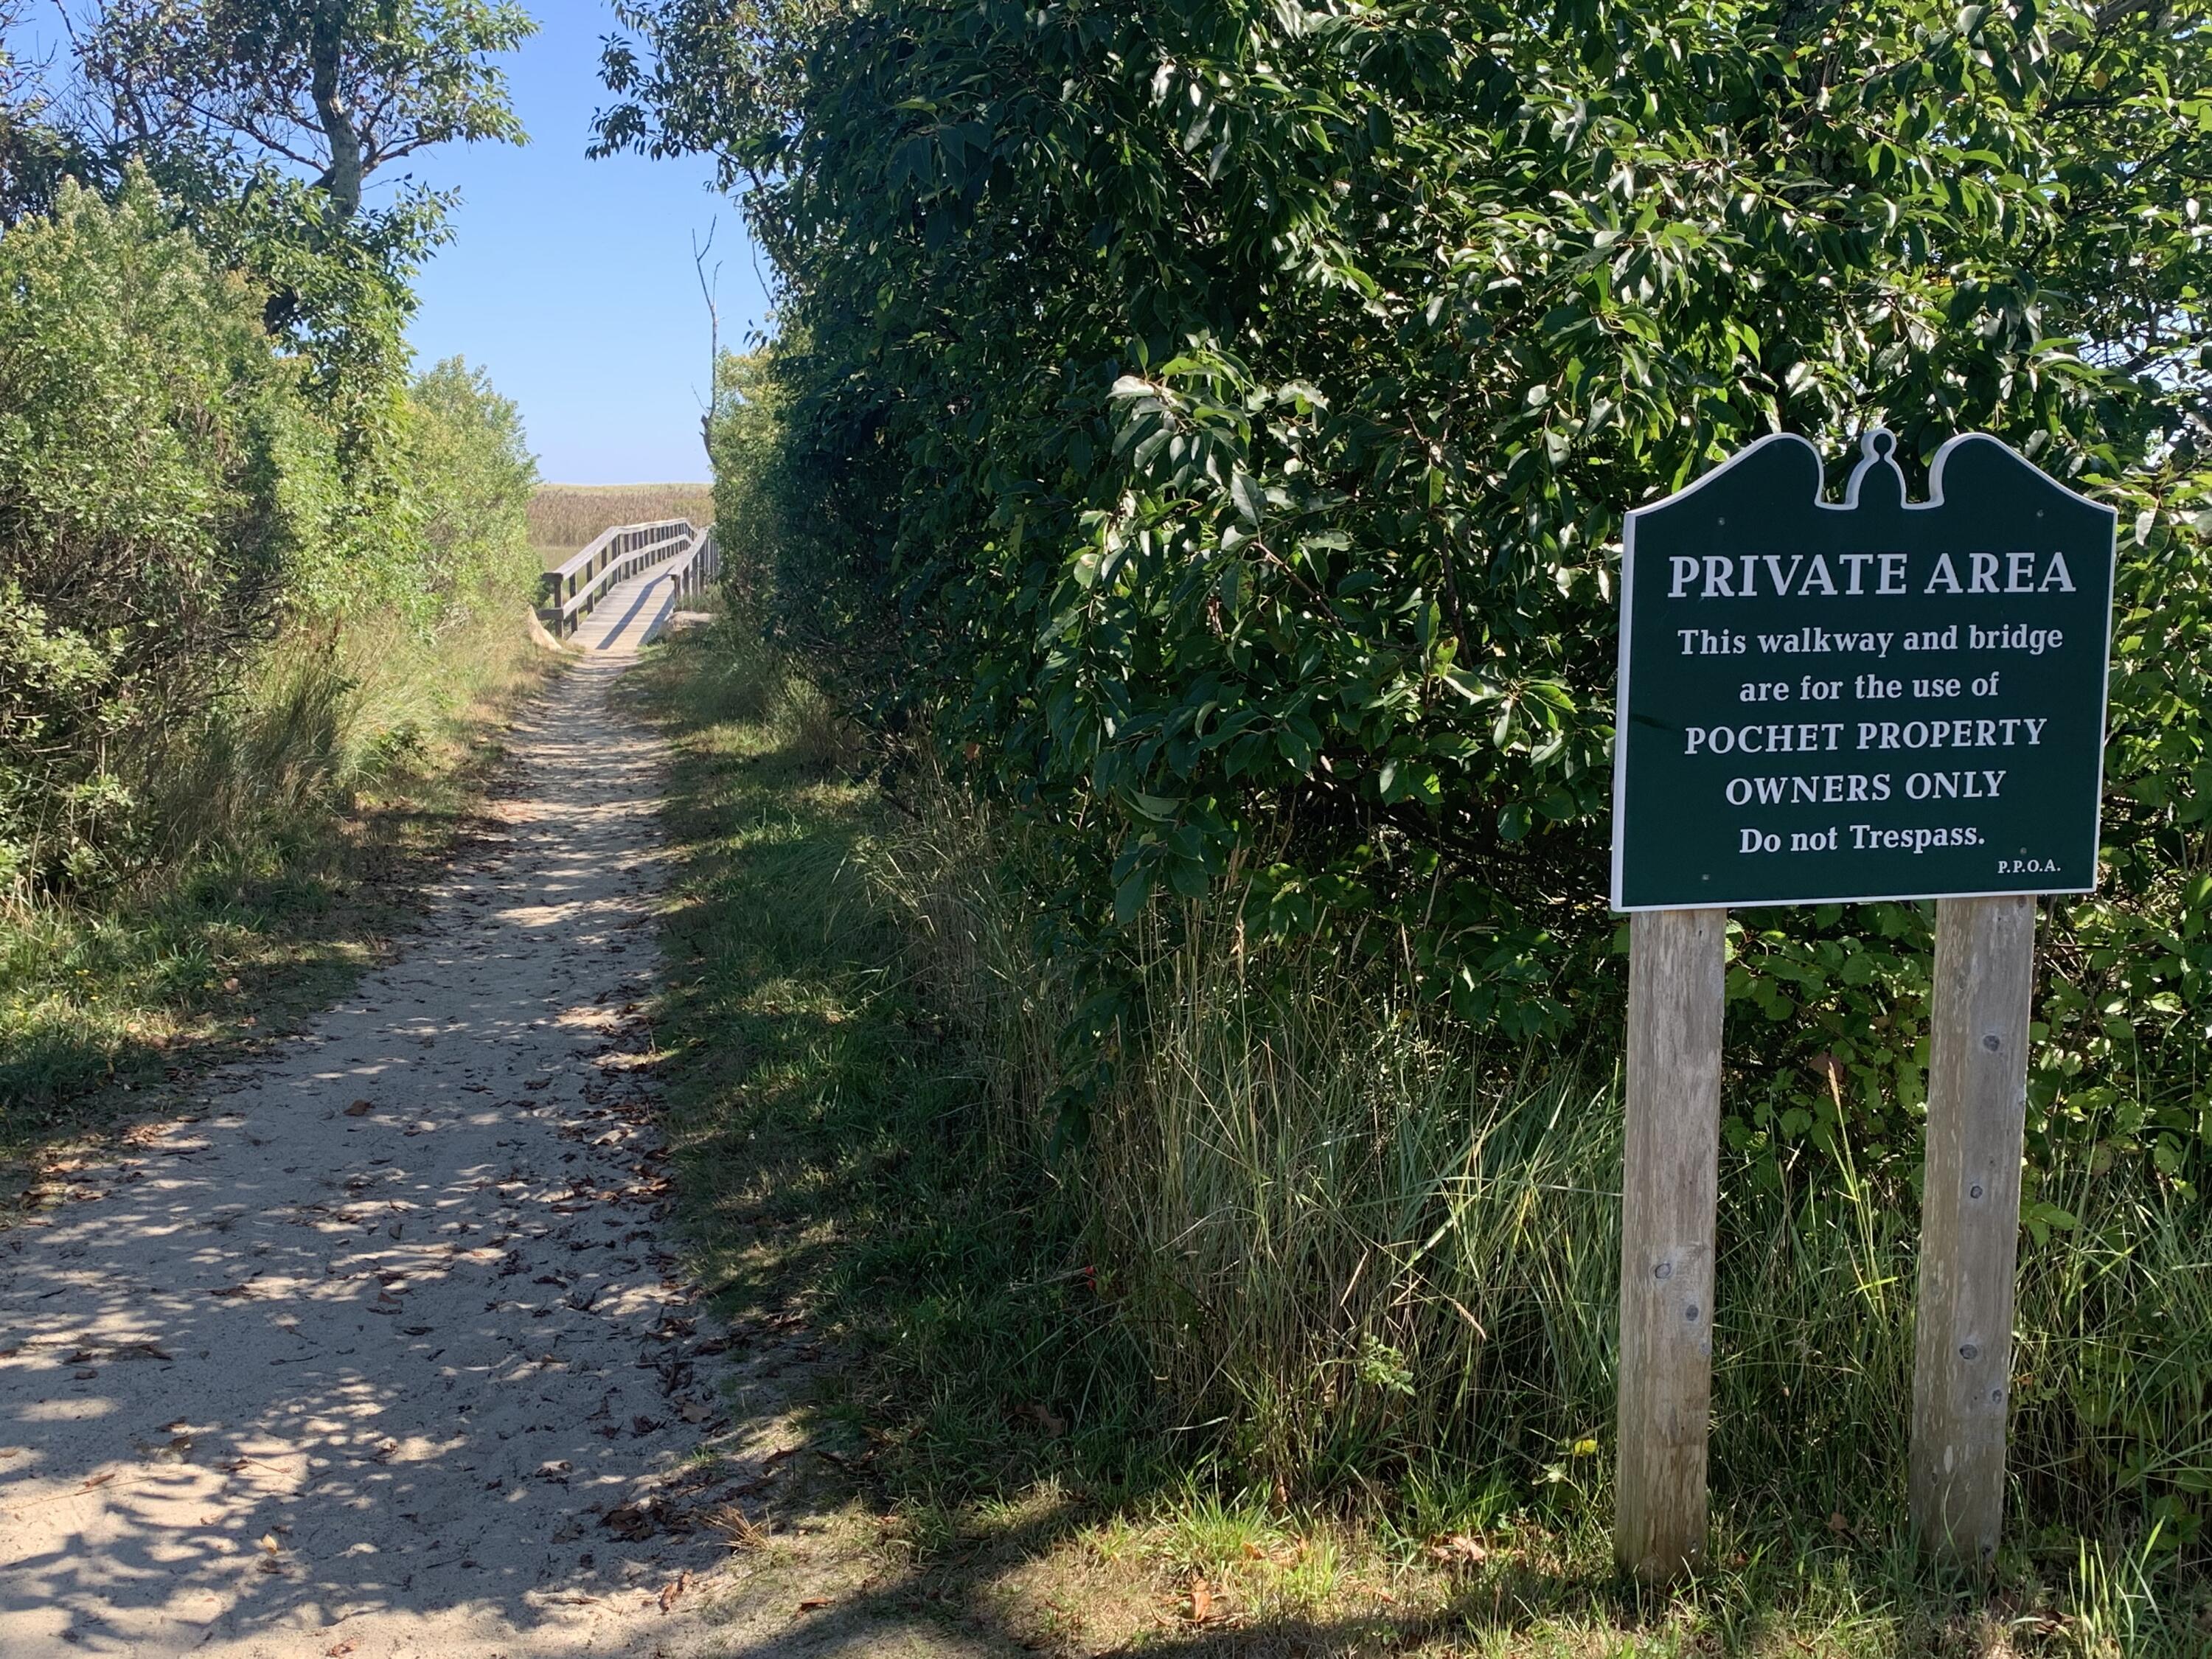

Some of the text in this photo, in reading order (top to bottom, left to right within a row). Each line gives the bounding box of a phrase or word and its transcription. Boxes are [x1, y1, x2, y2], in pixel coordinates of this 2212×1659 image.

[1668, 552, 2076, 597] PRIVATE AREA
[1677, 624, 2063, 658] This walkway and bridge
[1739, 671, 2000, 702] are for the use of
[1684, 718, 2048, 754] POCHET PROPERTY
[1725, 771, 2006, 805] OWNERS ONLY
[1739, 824, 1985, 854] Do not Trespass.
[1998, 859, 2061, 874] P.P.O.A.
